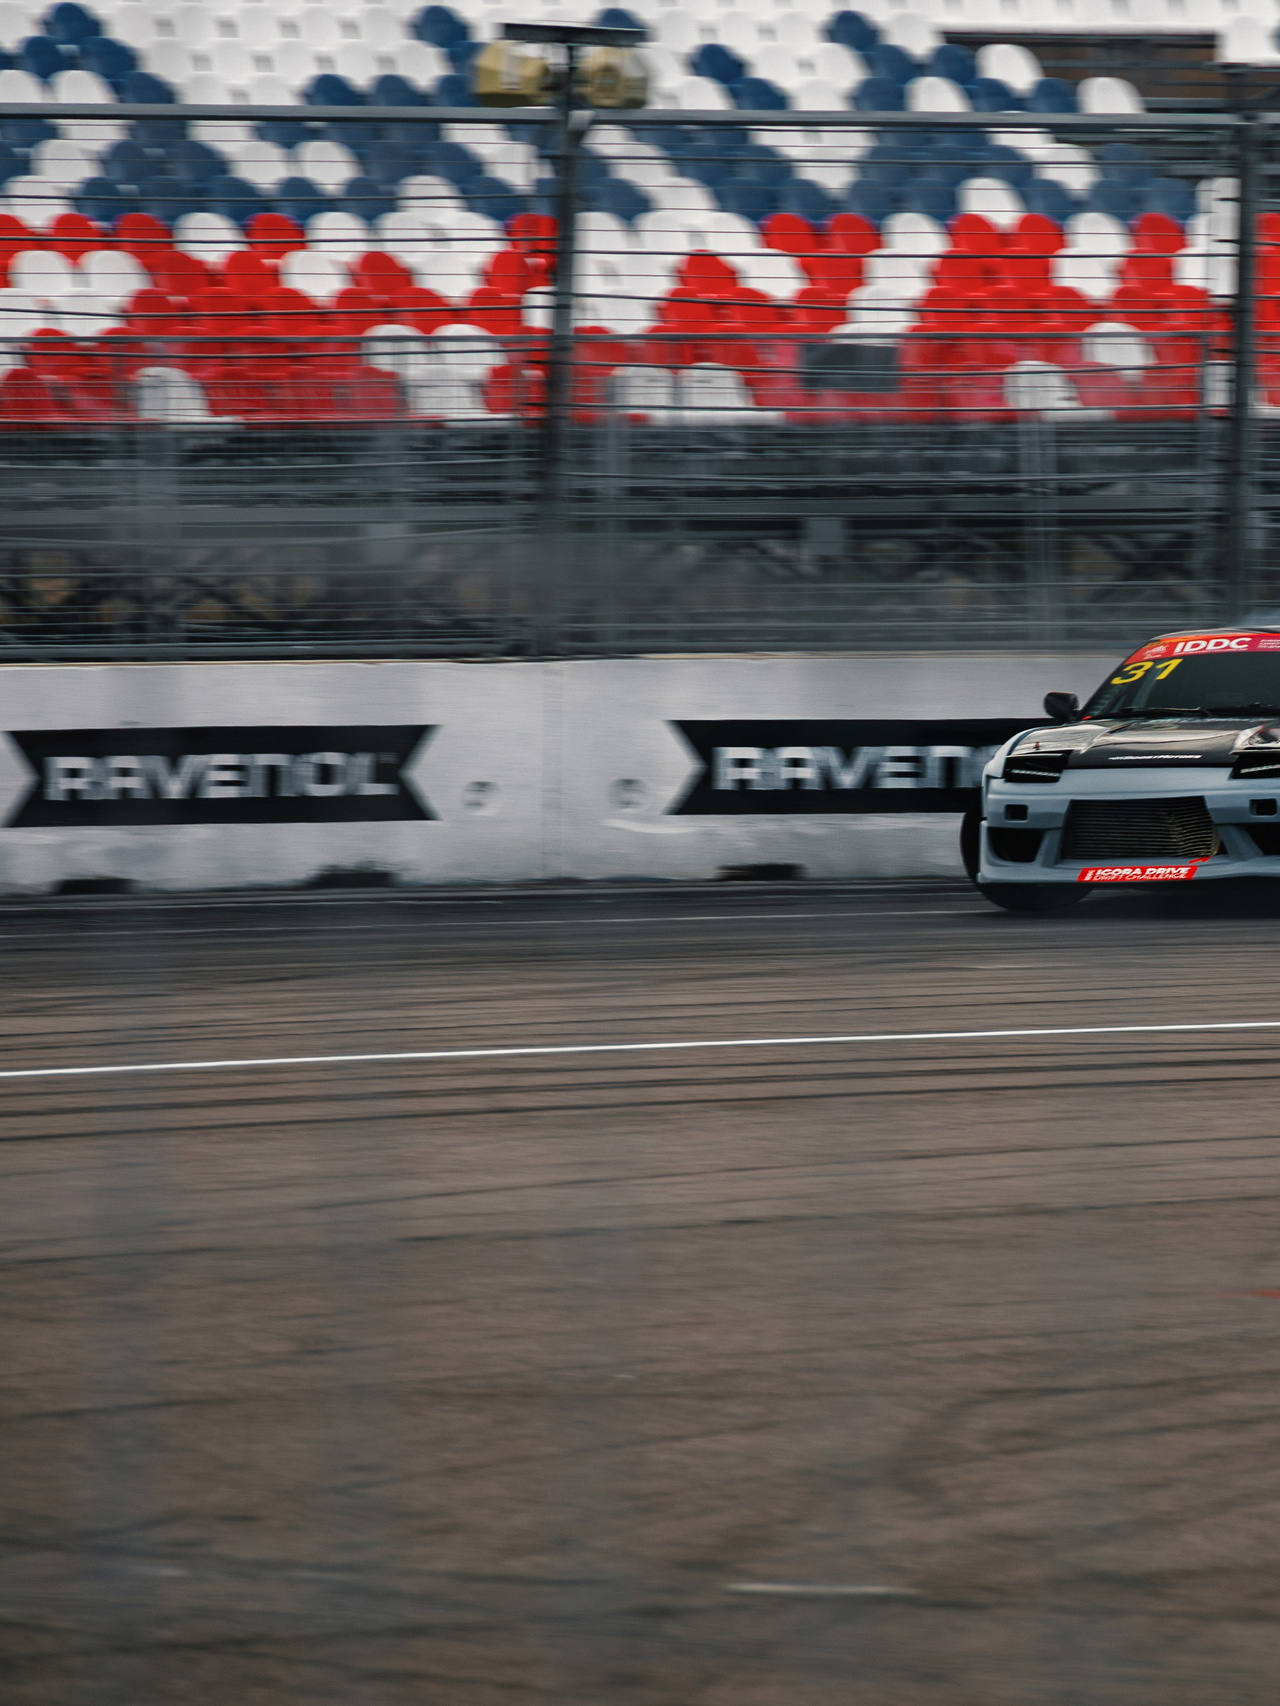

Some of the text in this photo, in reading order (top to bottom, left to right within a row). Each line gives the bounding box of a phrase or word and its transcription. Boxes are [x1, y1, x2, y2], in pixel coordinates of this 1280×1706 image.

[1173, 637, 1252, 653] IDDC
[1110, 658, 1184, 685] 31
[43, 752, 400, 801] RAVENOL
[711, 745, 994, 791] RAVEN
[1096, 867, 1142, 876] IGORA
